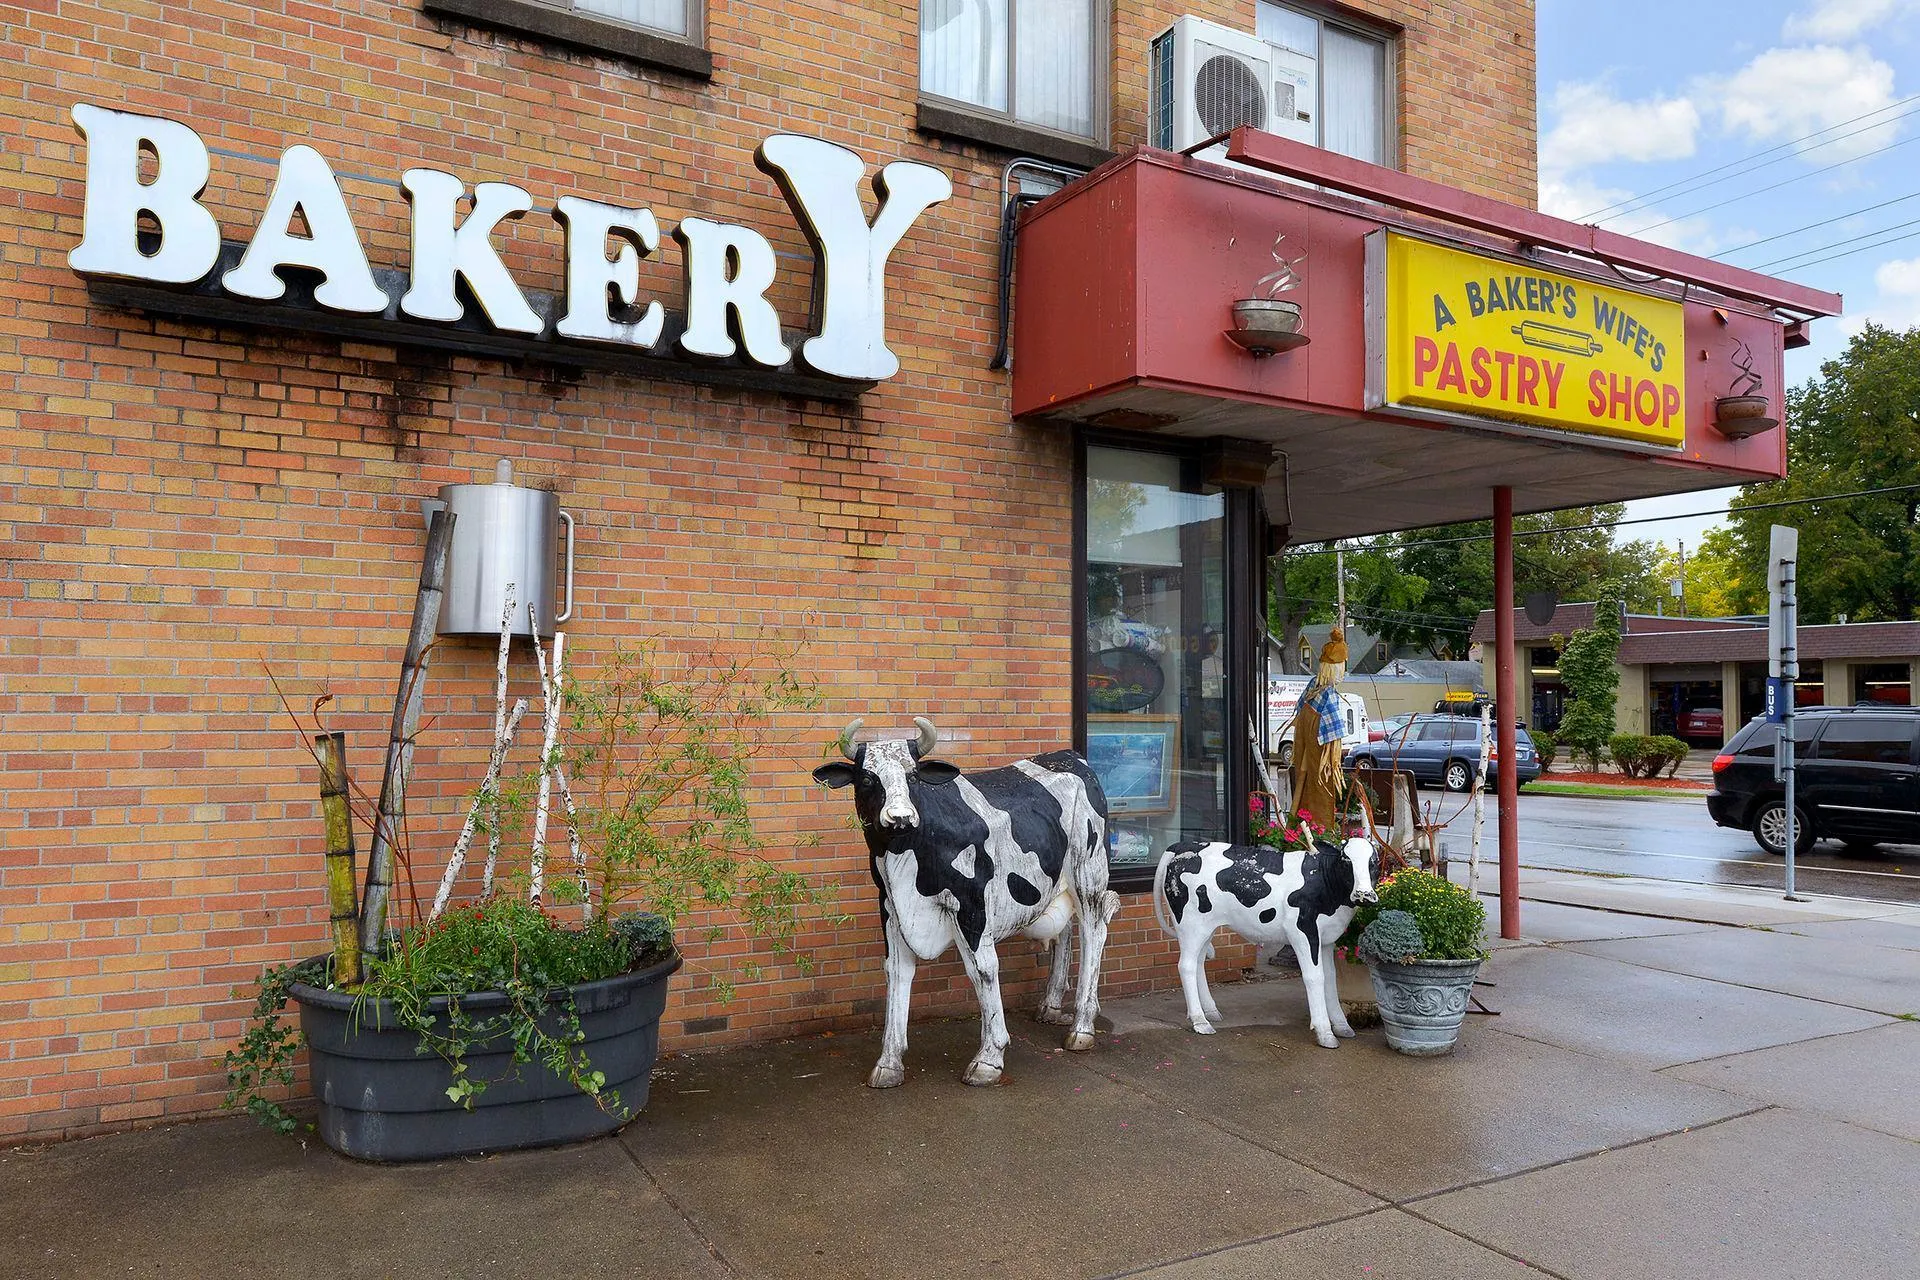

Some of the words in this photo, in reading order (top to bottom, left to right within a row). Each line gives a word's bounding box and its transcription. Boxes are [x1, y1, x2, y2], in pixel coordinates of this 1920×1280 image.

[67, 101, 953, 381] BAKERY
[1433, 293, 1456, 332] A
[1465, 276, 1577, 319] BAKER'S
[1593, 294, 1666, 372] WIFE'S
[1414, 335, 1565, 409] PASTRY
[1588, 369, 1680, 428] SHOP
